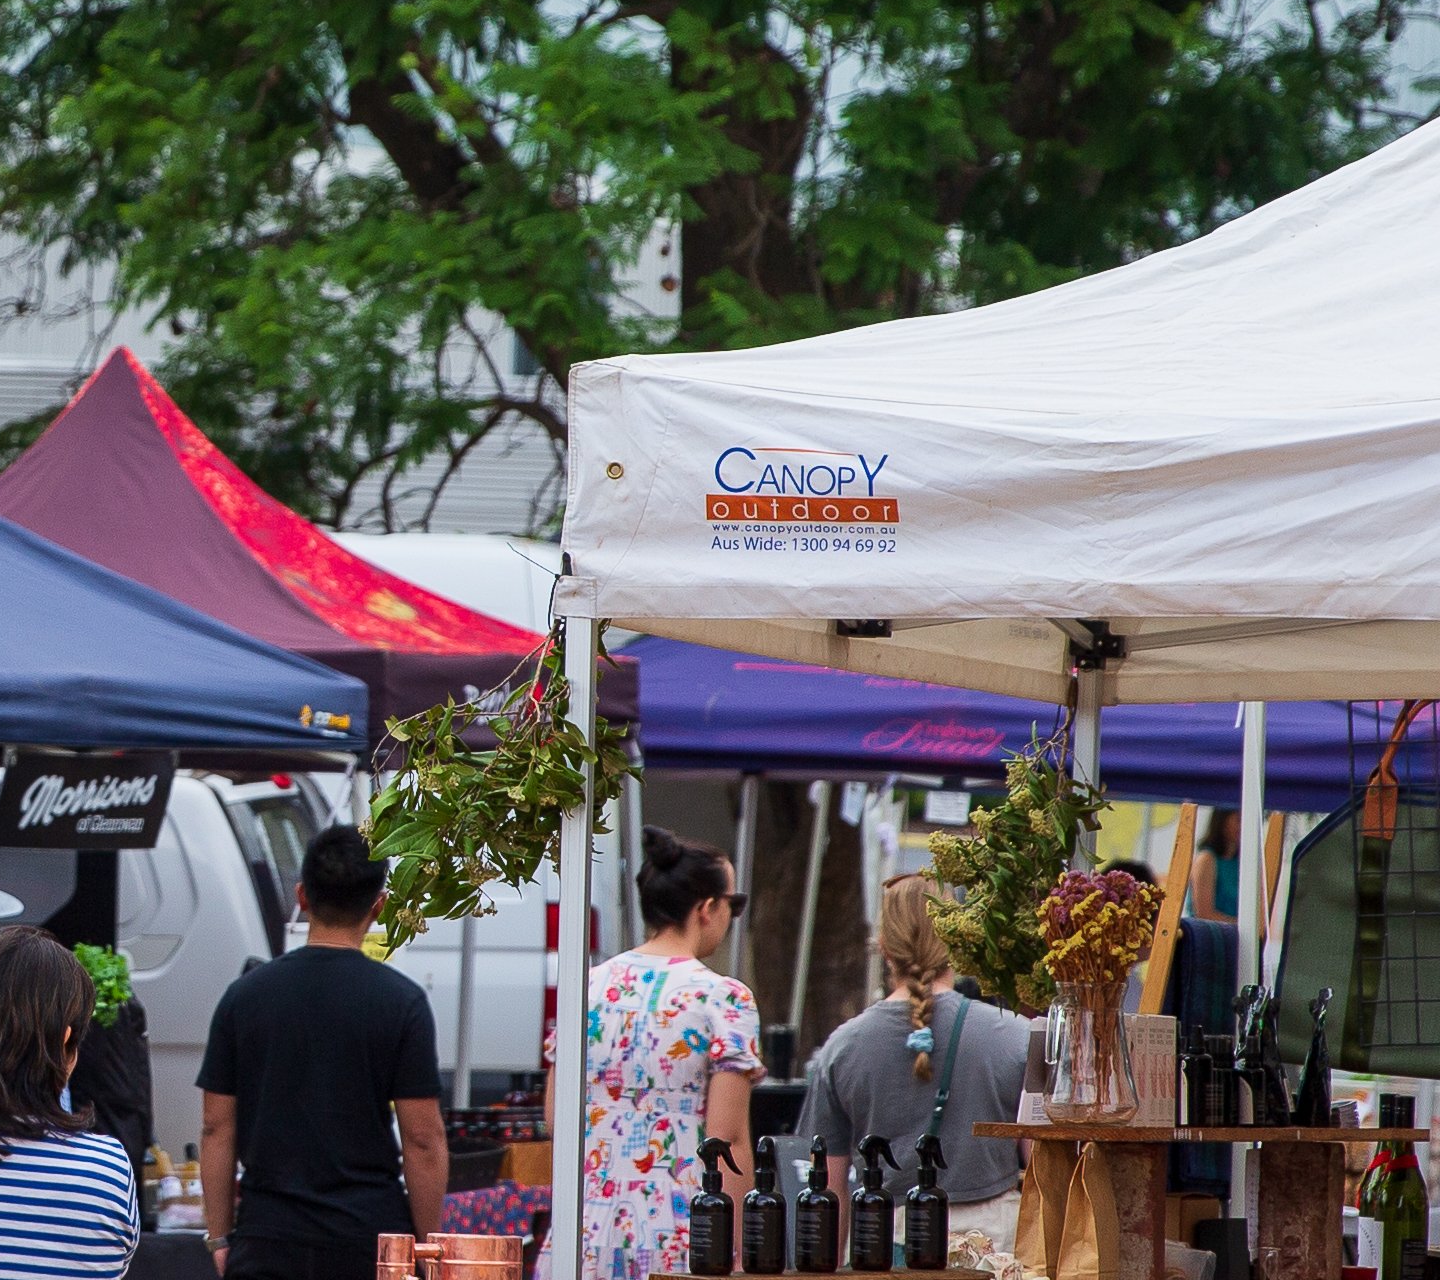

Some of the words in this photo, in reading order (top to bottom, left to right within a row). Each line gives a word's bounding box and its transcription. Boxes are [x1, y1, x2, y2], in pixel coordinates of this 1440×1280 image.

[712, 498, 891, 521] outdoor
[712, 523, 896, 535] www.canopyoutdoor.com.au
[711, 536, 740, 551] Aus
[744, 536, 788, 552] Wide:
[792, 537, 828, 552] 1300
[832, 538, 851, 552] 94
[855, 539, 874, 553] 69
[877, 540, 896, 553] 92
[17, 775, 159, 831] Morrisons
